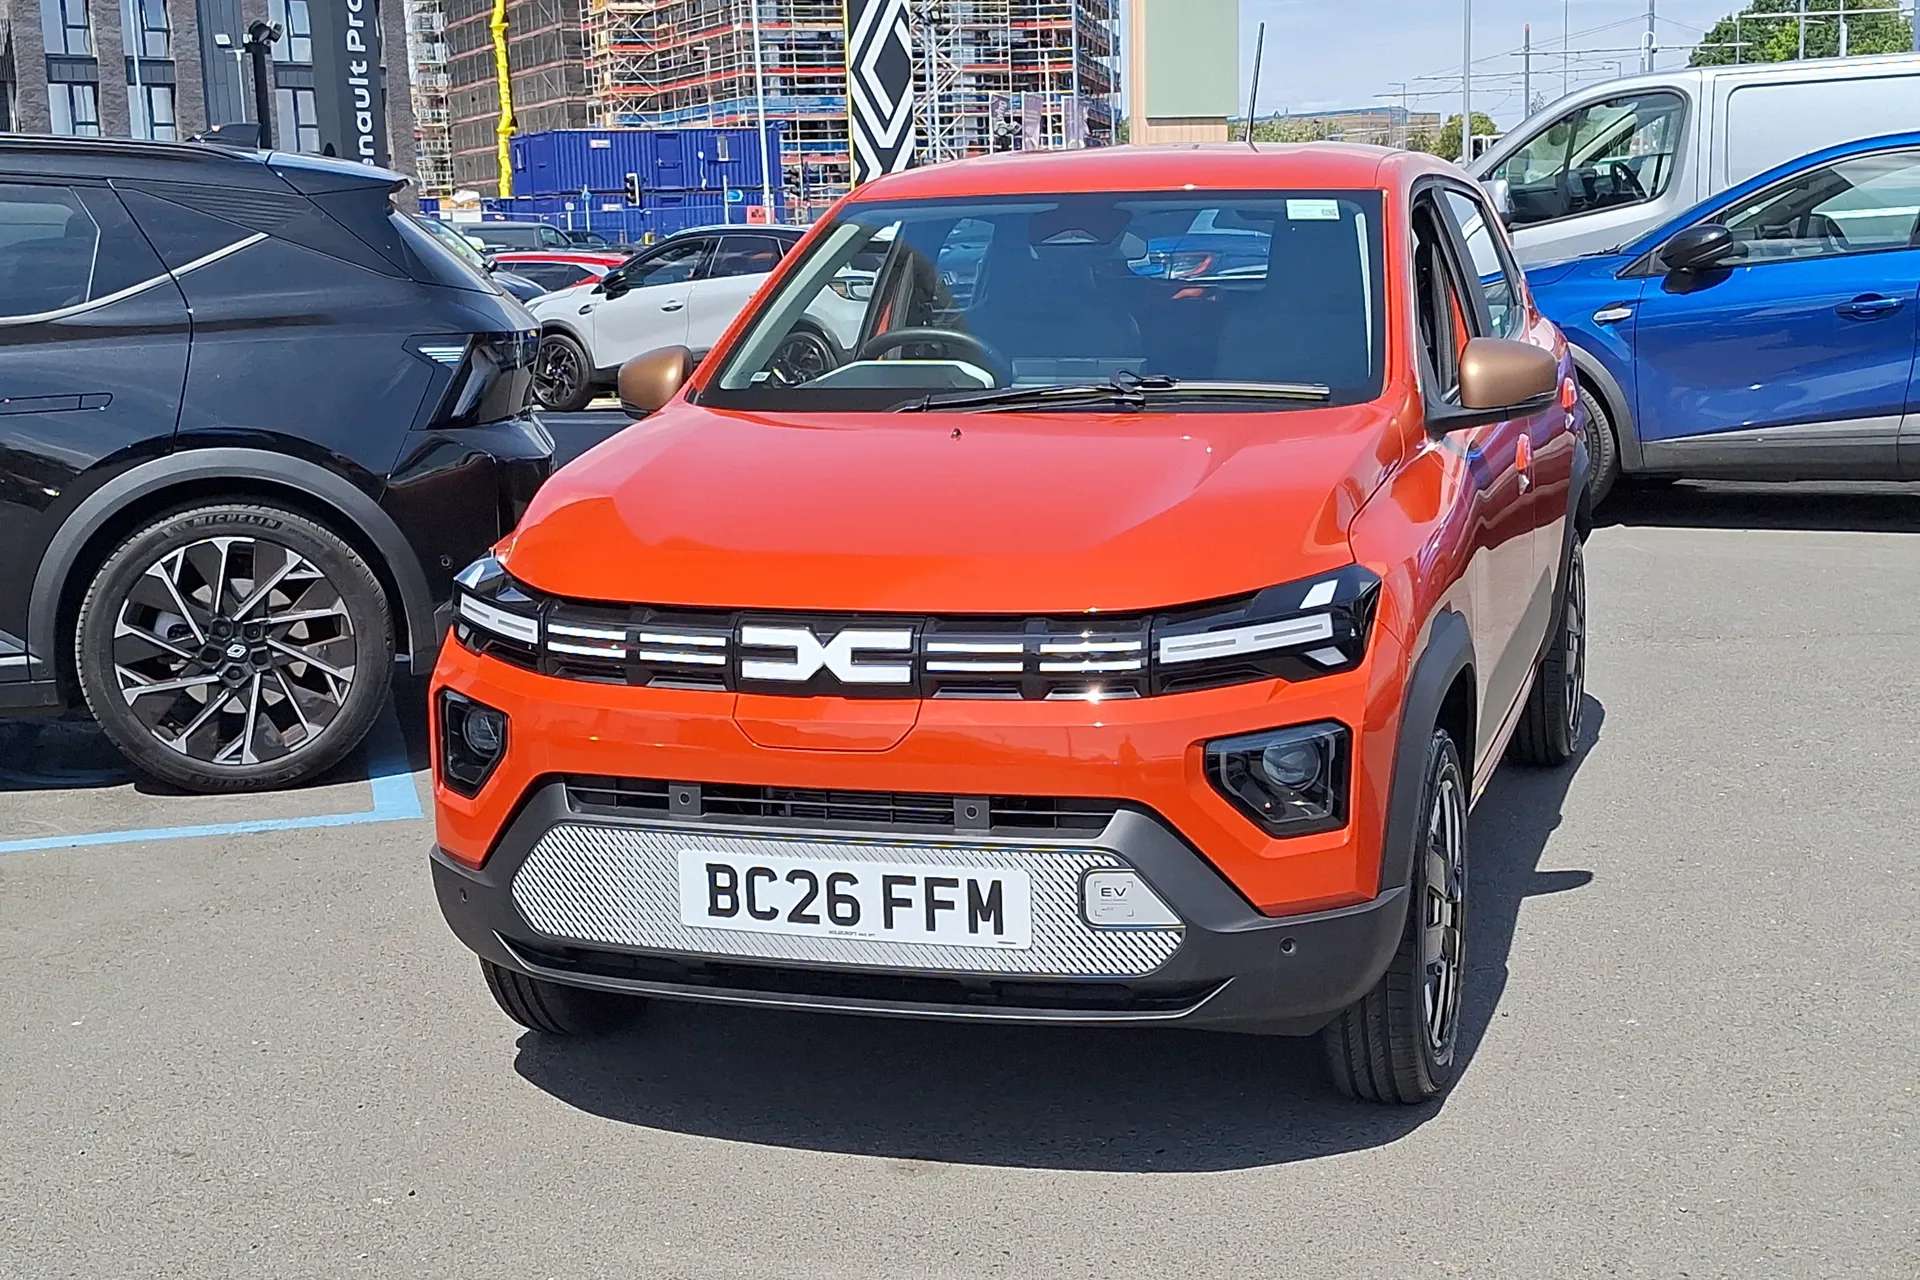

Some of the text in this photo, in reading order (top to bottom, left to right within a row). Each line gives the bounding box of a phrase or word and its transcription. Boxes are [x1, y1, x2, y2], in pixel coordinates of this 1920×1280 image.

[193, 513, 280, 529] MICHELIN
[705, 863, 1004, 936] BC26 FFM
[1100, 887, 1127, 897] EV
